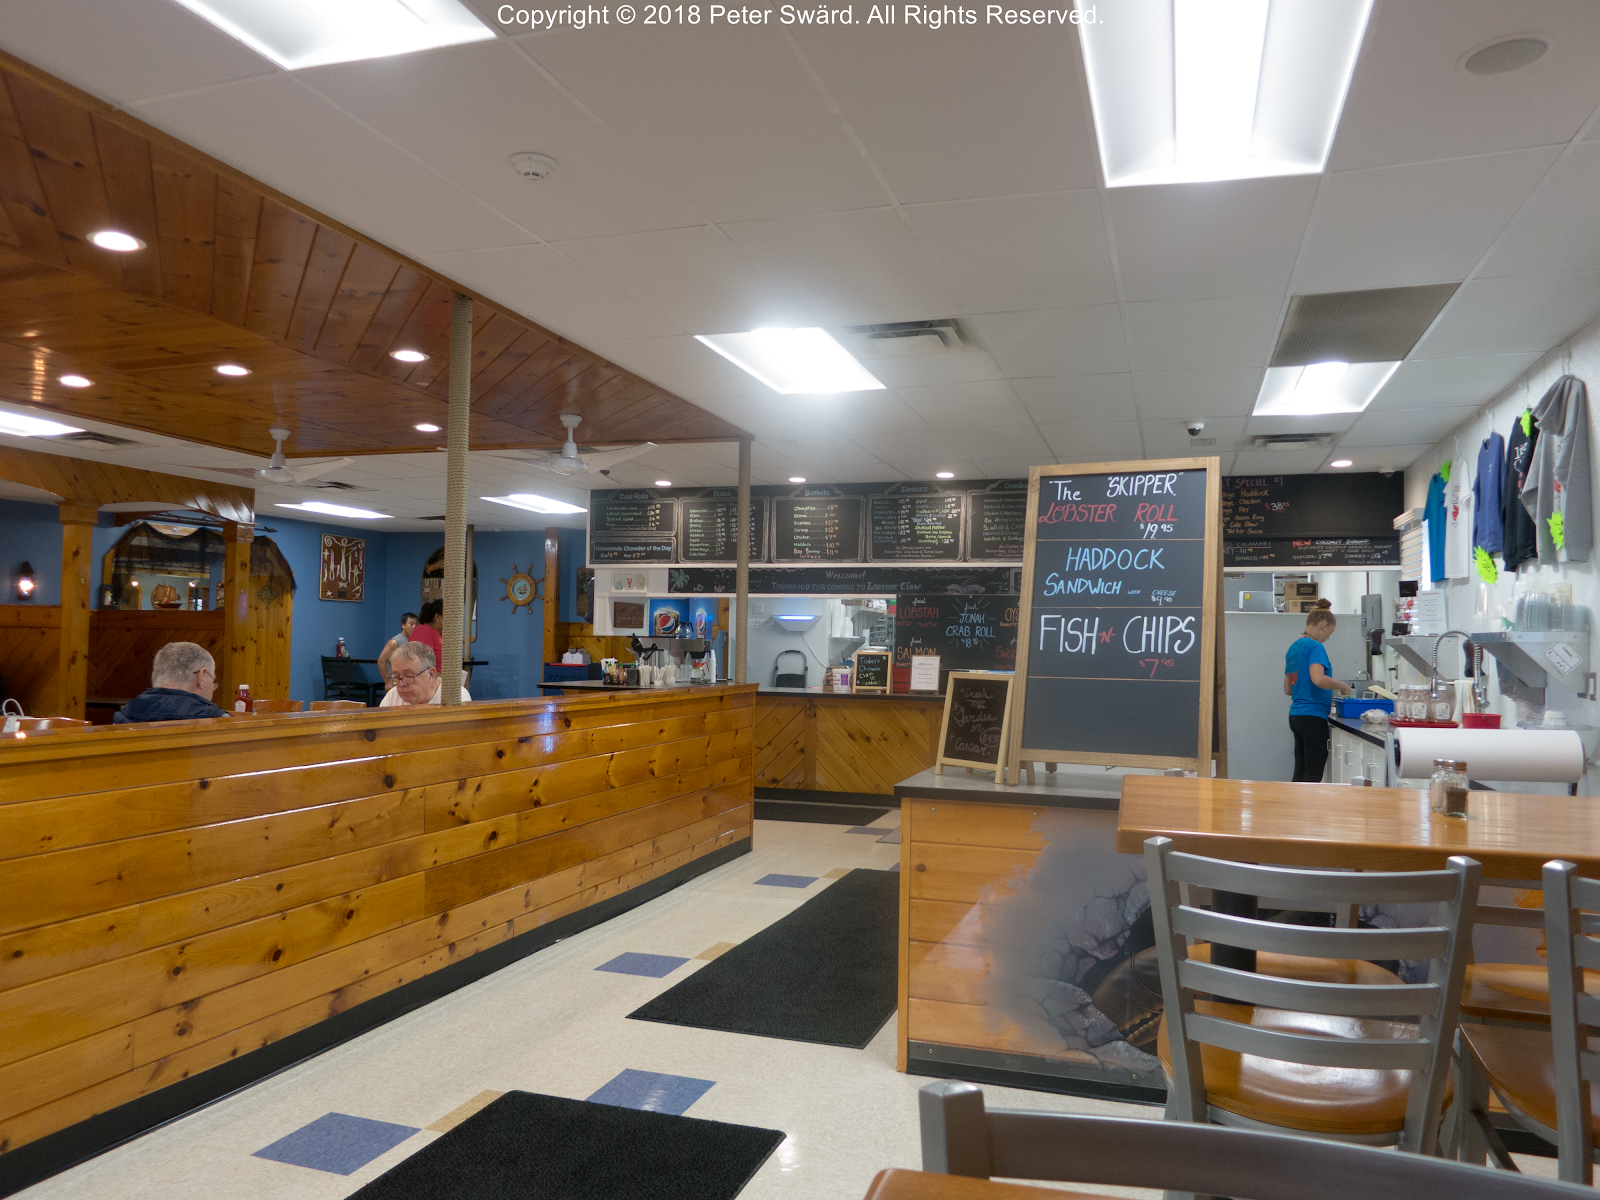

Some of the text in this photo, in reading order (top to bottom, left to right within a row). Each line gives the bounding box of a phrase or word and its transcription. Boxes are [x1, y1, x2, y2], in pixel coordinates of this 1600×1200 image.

[1234, 478, 1270, 488] SPECIAL
[1049, 479, 1082, 501] The
[1240, 489, 1269, 497] Haddock
[1038, 502, 1179, 524] LOBSTER ROLL
[1292, 539, 1312, 548] NEW
[1066, 547, 1165, 571] HADDOCK
[811, 583, 826, 591] FOR
[856, 583, 866, 591] TO
[1043, 572, 1122, 597] SANDWICH
[1152, 589, 1177, 597] CHEESE
[899, 606, 940, 619] LOBSTAH
[959, 613, 985, 624] JONAH
[945, 625, 997, 638] CRAB ROLL
[1039, 614, 1099, 655] FISH
[1123, 615, 1196, 655] CHIPS
